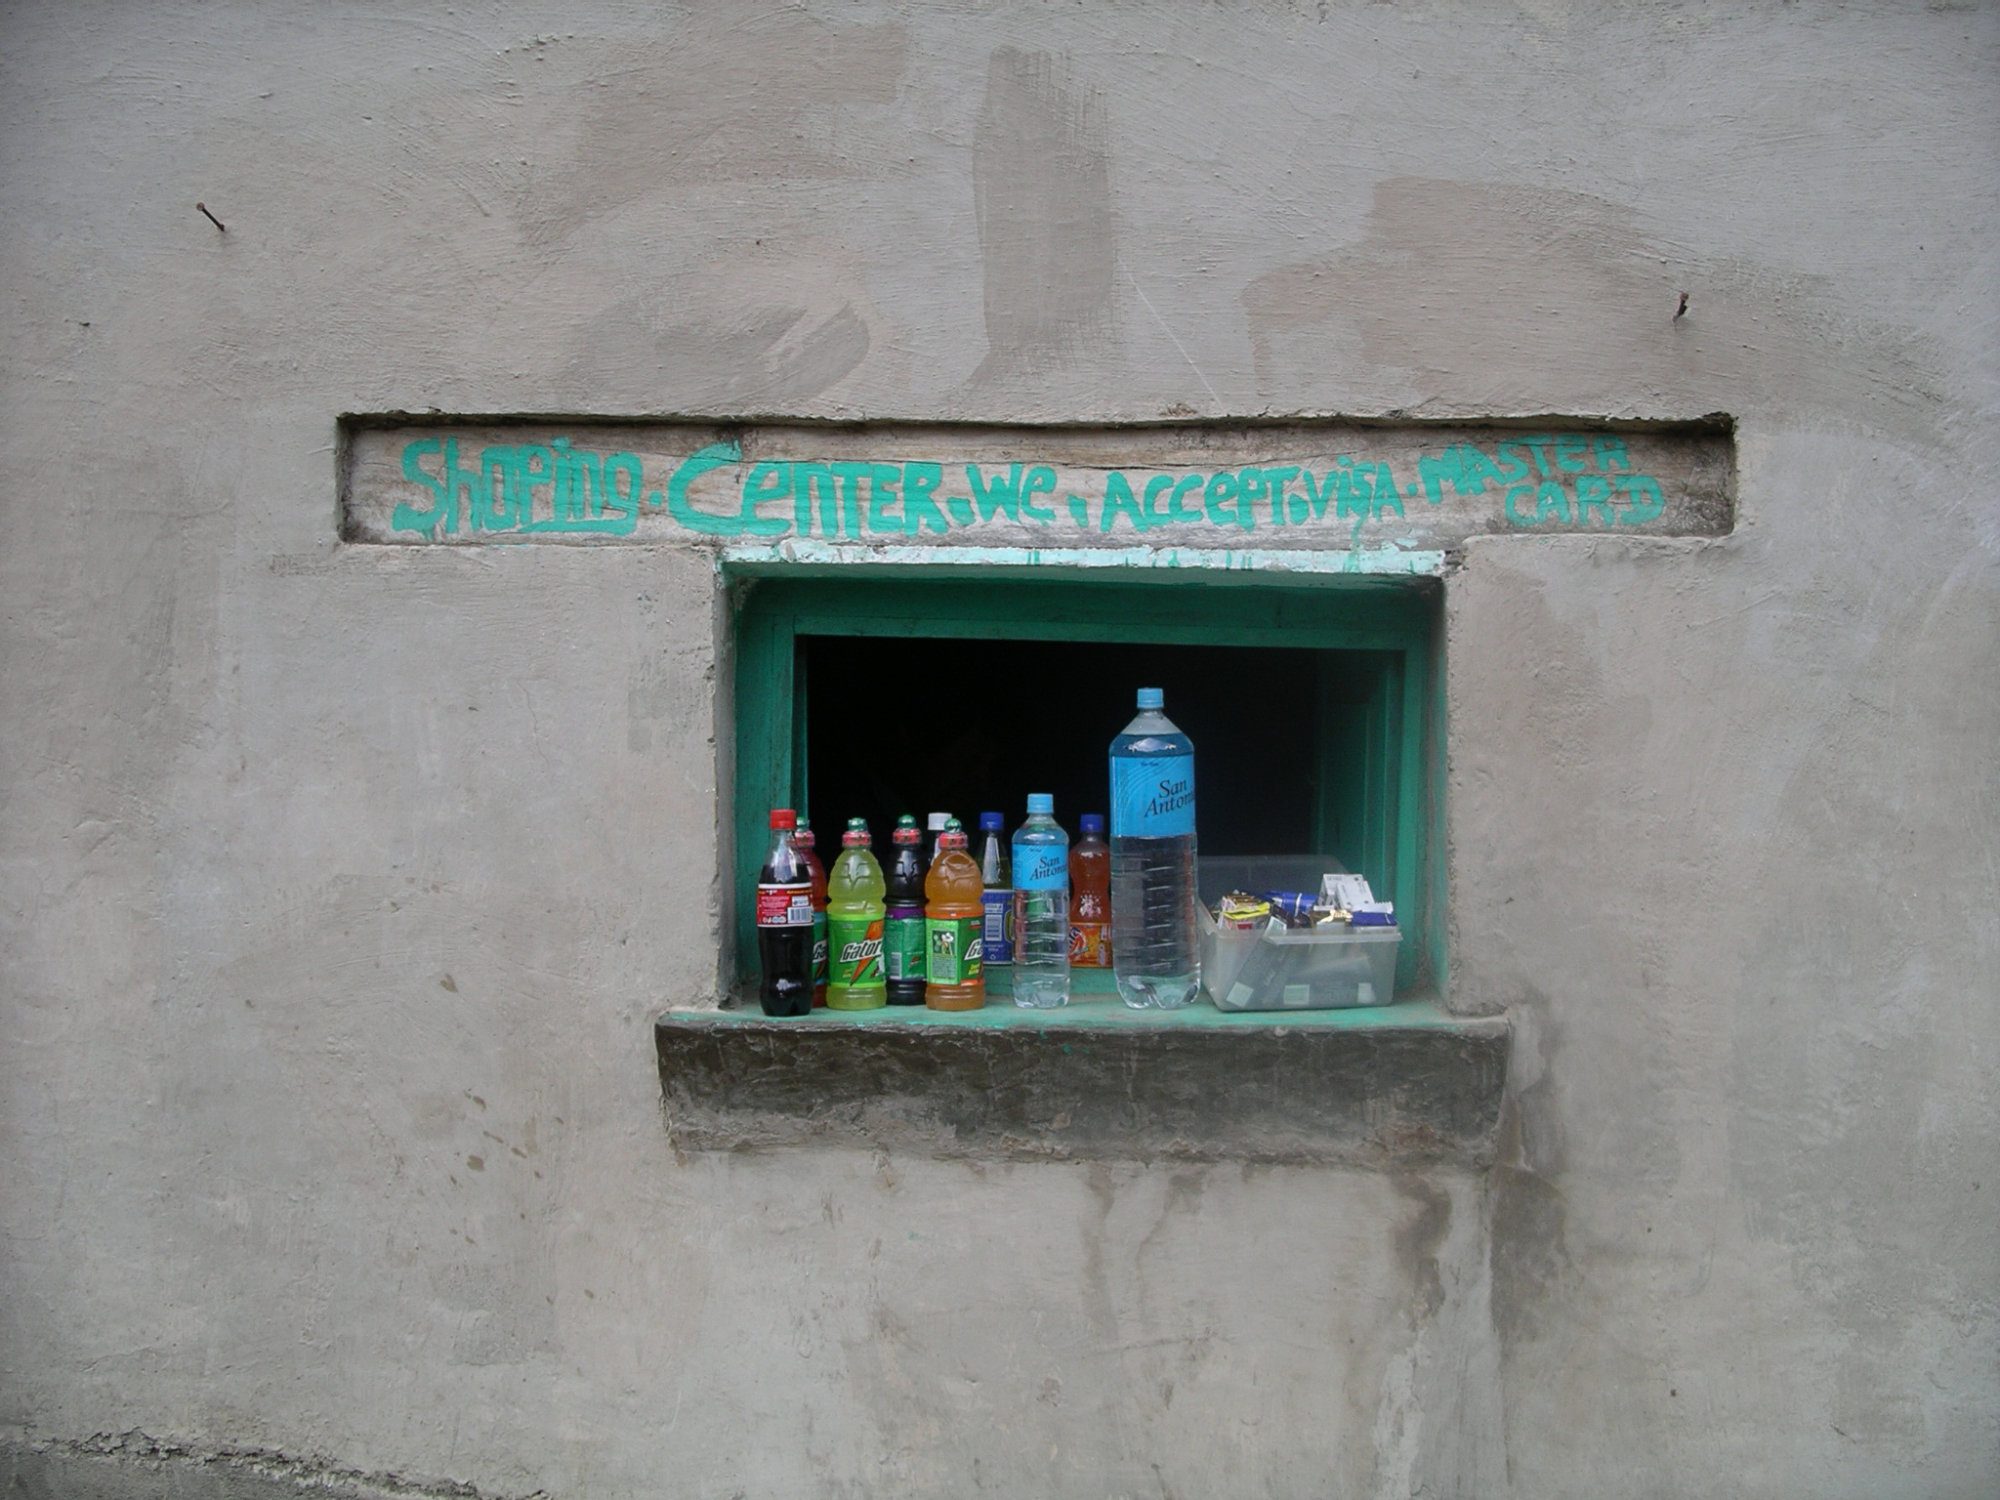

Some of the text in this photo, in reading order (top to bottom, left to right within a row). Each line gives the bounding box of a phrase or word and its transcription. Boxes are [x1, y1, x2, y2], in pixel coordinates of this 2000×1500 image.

[1504, 475, 1666, 527] CARD
[1158, 779, 1188, 799] San
[1039, 856, 1060, 871] San
